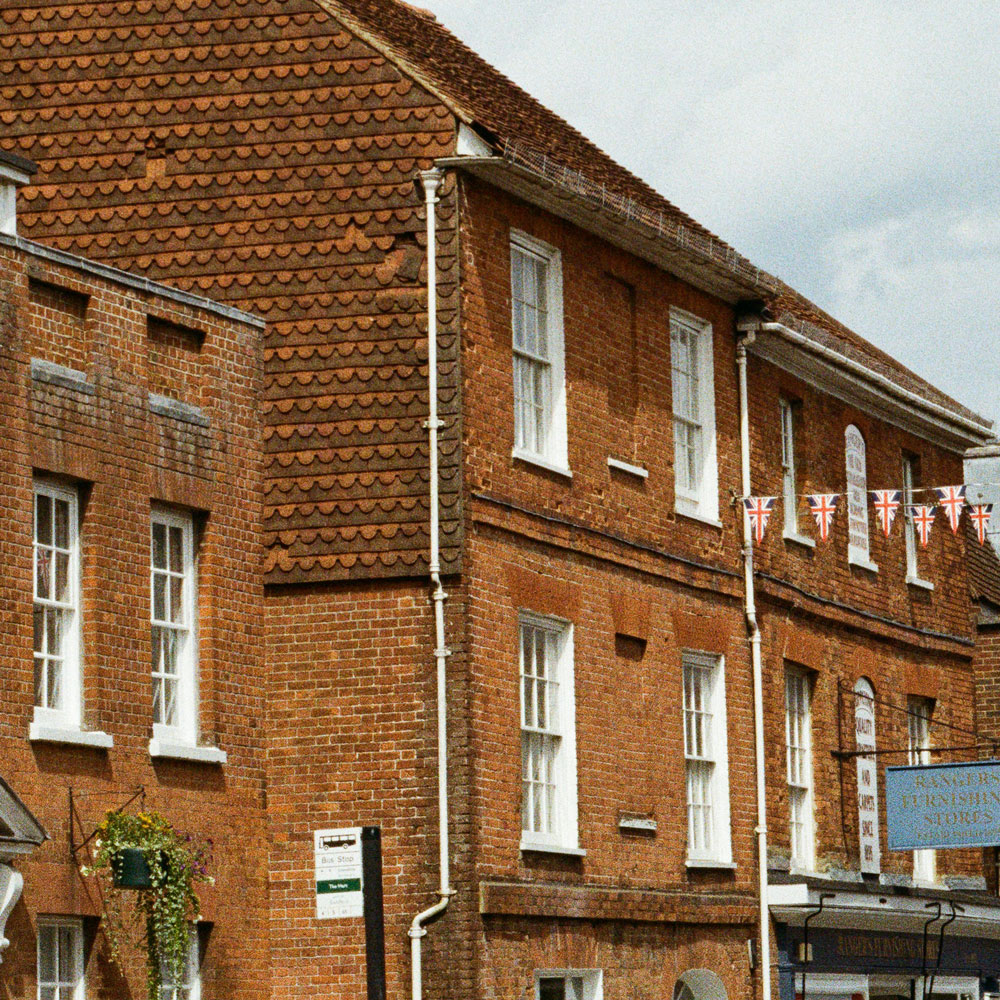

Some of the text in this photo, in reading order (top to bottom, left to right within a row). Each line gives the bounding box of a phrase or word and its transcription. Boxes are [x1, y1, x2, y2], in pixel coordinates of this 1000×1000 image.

[915, 771, 1000, 789] RANGERS
[924, 810, 993, 826] STORES
[321, 856, 334, 864] Bus
